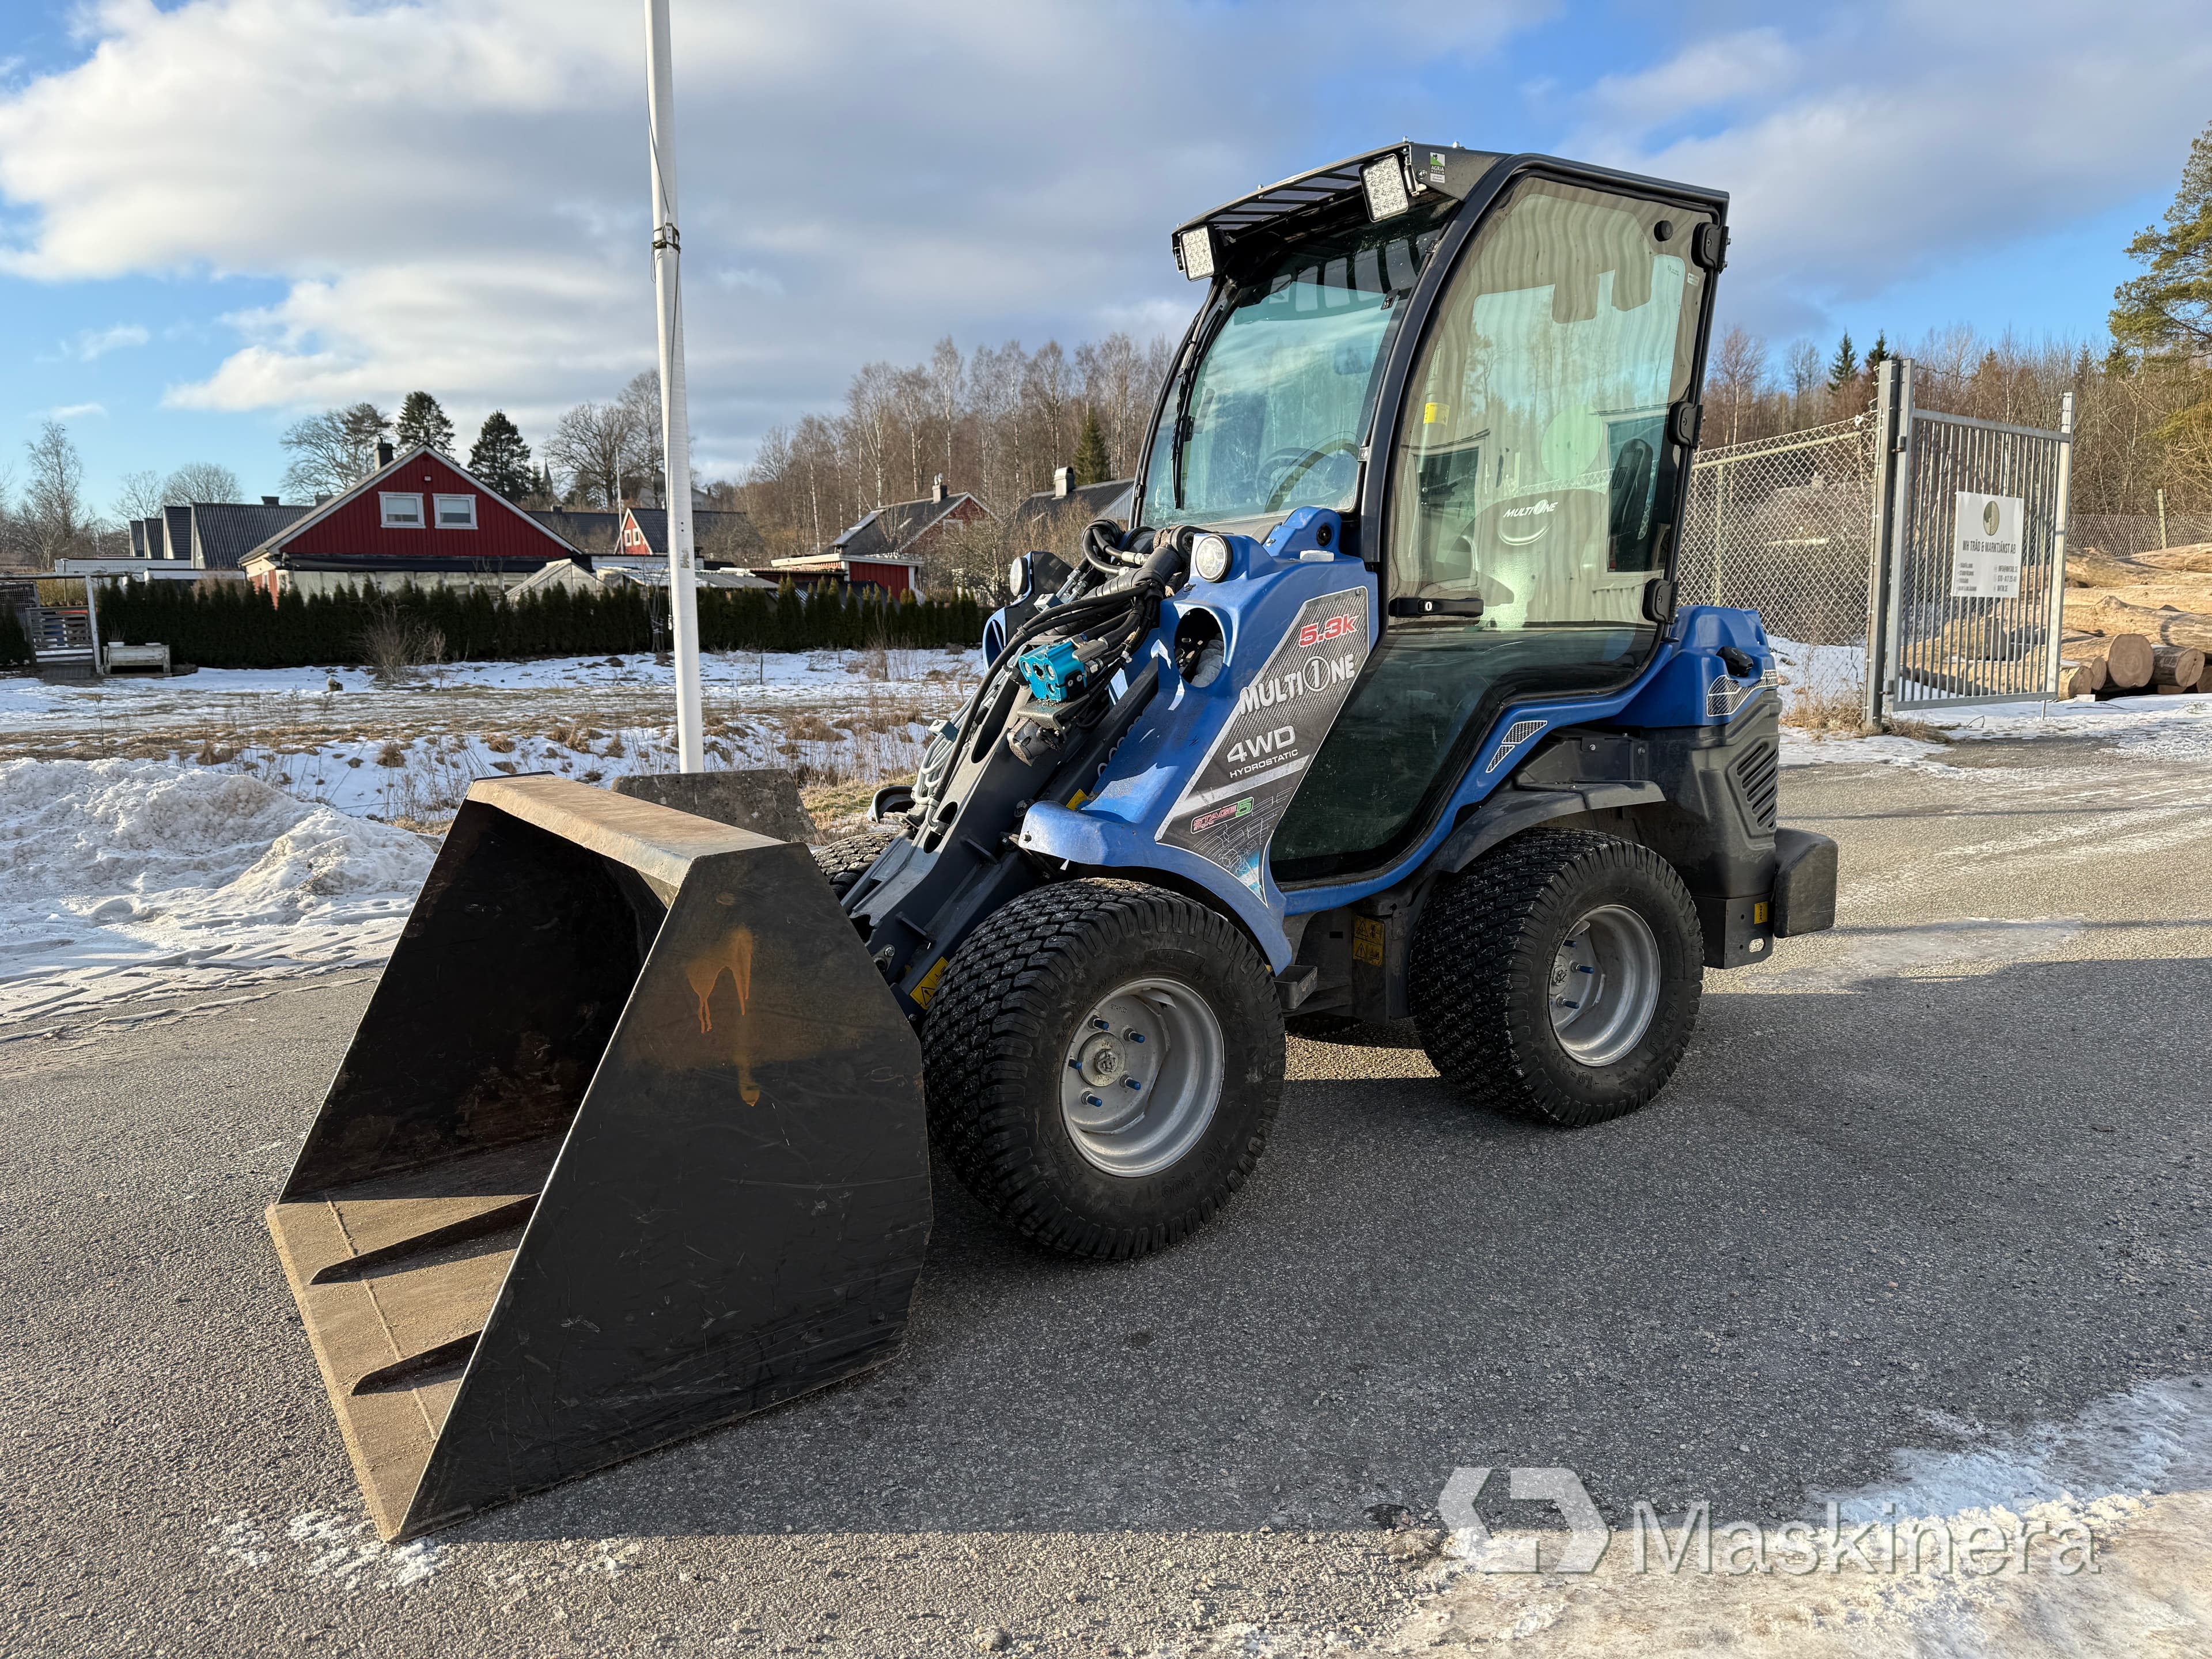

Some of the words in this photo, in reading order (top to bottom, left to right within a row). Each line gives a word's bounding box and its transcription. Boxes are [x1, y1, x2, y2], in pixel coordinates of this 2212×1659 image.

[2010, 543, 2016, 554] AB
[1299, 614, 1358, 647] 5.3k
[1226, 725, 1296, 763] 4WD
[1229, 749, 1298, 778] HYDROSTATIC
[1193, 805, 1237, 827] STAGE
[1235, 797, 1253, 817] 5
